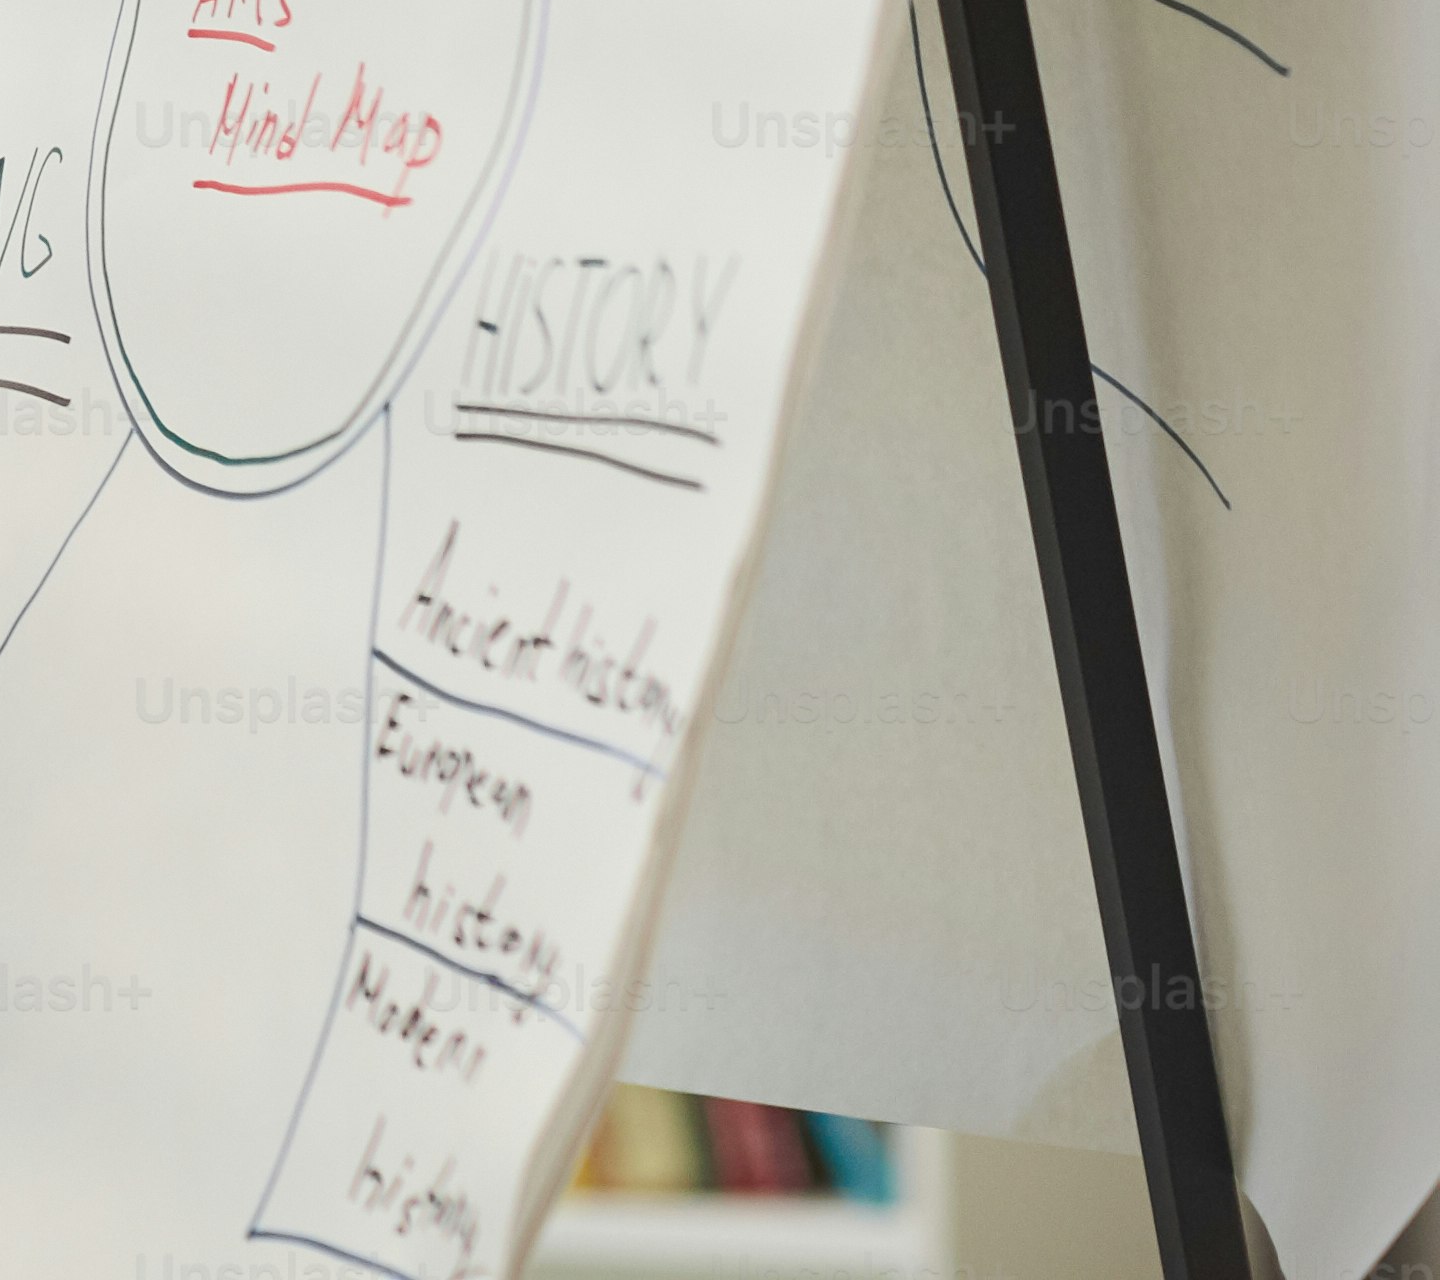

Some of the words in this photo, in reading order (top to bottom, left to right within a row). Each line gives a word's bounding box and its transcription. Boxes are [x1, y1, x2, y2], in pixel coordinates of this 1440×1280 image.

[209, 71, 323, 166] Mind
[329, 61, 445, 220] Map
[401, 837, 561, 1026] history
[344, 948, 487, 1085] Modern
